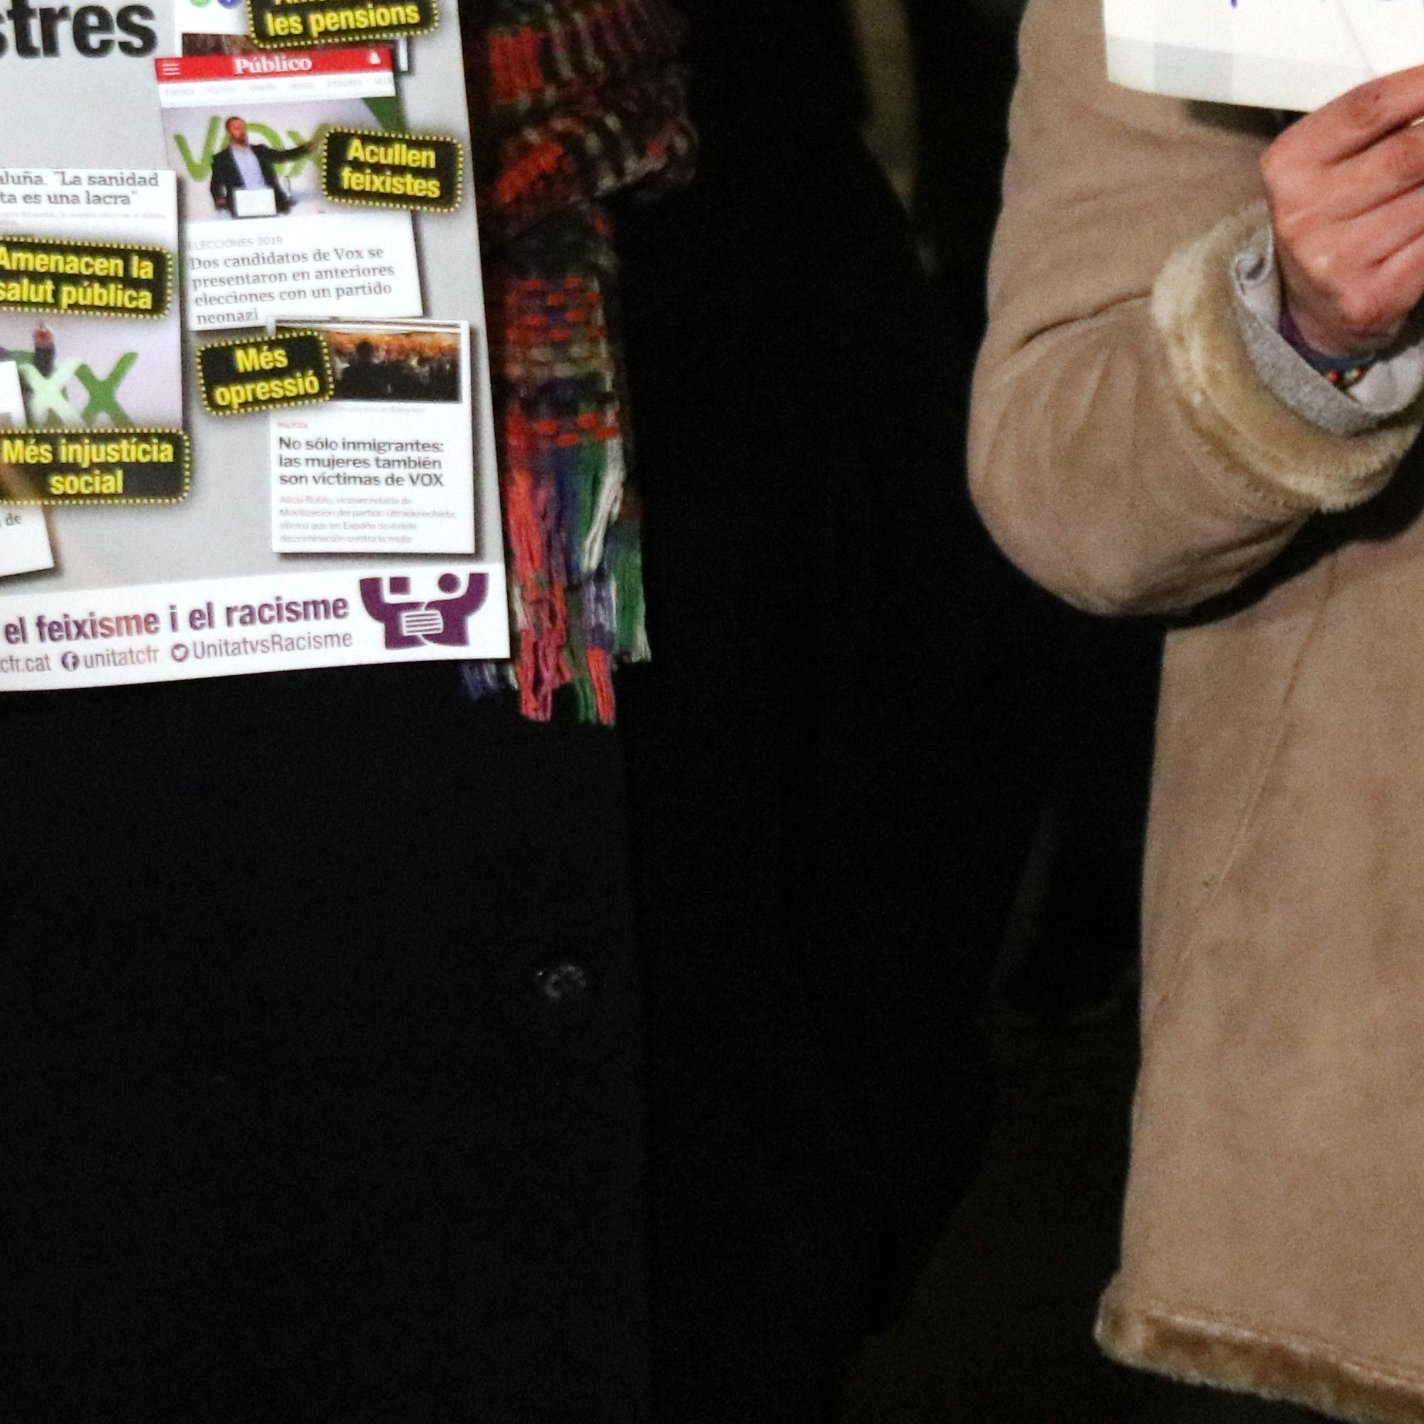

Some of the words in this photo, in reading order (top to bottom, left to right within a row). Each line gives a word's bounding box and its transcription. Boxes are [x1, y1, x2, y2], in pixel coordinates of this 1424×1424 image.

[265, 14, 303, 37] les
[310, 3, 420, 36] pensions
[234, 55, 313, 75] Público
[348, 138, 436, 169] Acullen
[87, 172, 160, 187] sanidad
[342, 167, 441, 198] feixistes
[22, 193, 42, 206] es
[47, 193, 81, 206] una
[133, 255, 154, 279] la
[191, 257, 220, 270] Dos
[224, 251, 309, 269] candidatos
[312, 248, 331, 262] de
[334, 247, 365, 260] Vox
[368, 246, 384, 258] se
[192, 271, 288, 291] presentaron
[292, 270, 311, 282] en
[314, 264, 395, 281] anteriores
[61, 281, 153, 311] pública
[194, 289, 276, 307] elecciones
[279, 287, 307, 301] con
[311, 286, 332, 298] un
[335, 281, 393, 300] partido
[196, 308, 258, 325] neonazi
[235, 346, 288, 373] Més
[215, 370, 320, 409] opressió
[2, 437, 53, 464] Més
[60, 435, 174, 467] injustícia
[278, 436, 302, 450] No
[305, 436, 339, 451] sólo
[341, 437, 445, 455] inmigrantes:
[278, 454, 302, 468] las
[305, 455, 371, 470] mujeres
[374, 456, 443, 470] también
[49, 469, 124, 496] social
[279, 473, 308, 486] son
[311, 472, 381, 486] víctimas
[384, 473, 405, 487] de
[408, 473, 445, 487] VOX
[4, 512, 22, 526] de
[5, 616, 28, 644] el
[35, 610, 161, 643] feixisme
[169, 604, 178, 633] i
[188, 601, 216, 631] el
[225, 595, 350, 628] racisme
[192, 630, 354, 660] UnitatvsRacisme
